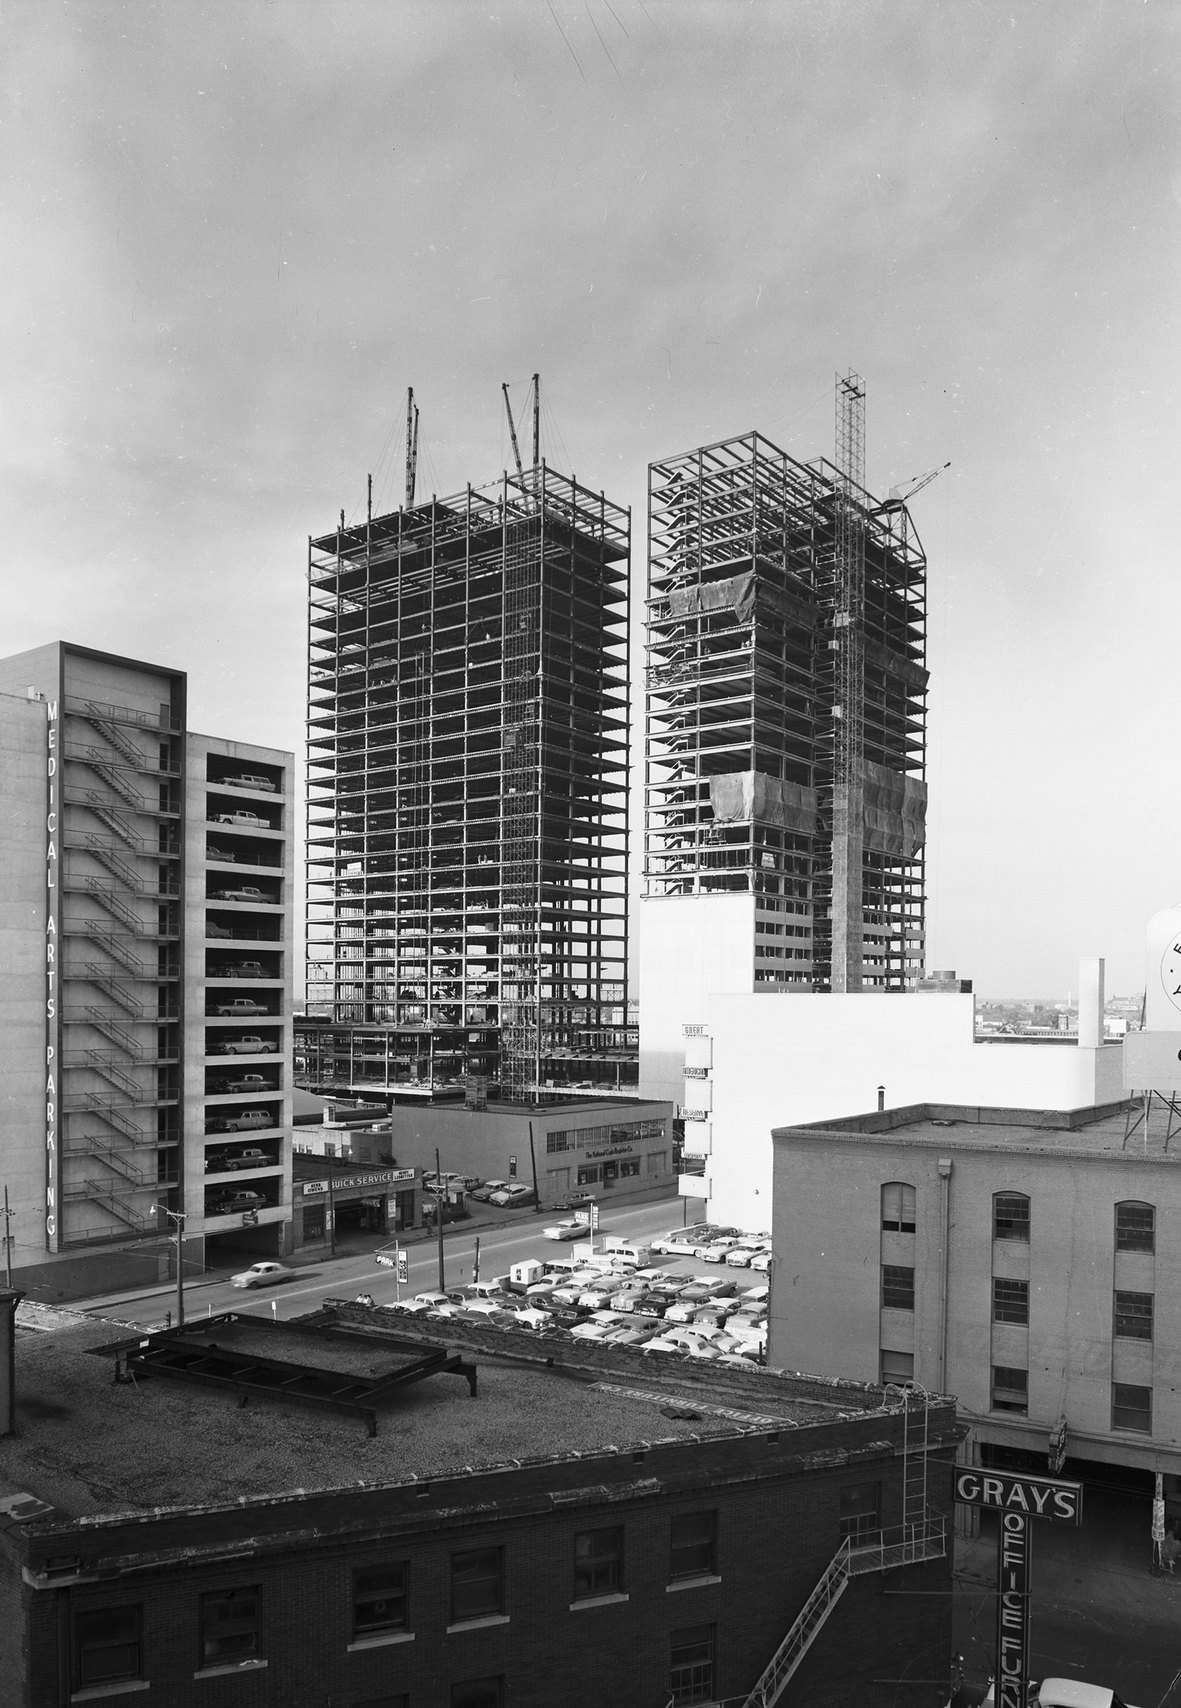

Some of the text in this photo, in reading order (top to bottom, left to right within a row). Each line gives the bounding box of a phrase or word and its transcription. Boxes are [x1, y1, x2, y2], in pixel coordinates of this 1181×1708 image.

[46, 701, 58, 1236] MEDICAL ARTS PARKING
[332, 1172, 392, 1189] BUICK SERVICE
[376, 1255, 394, 1267] PARK
[957, 1474, 1076, 1519] GRAY'S
[1002, 1513, 1025, 1630] OFFICE
